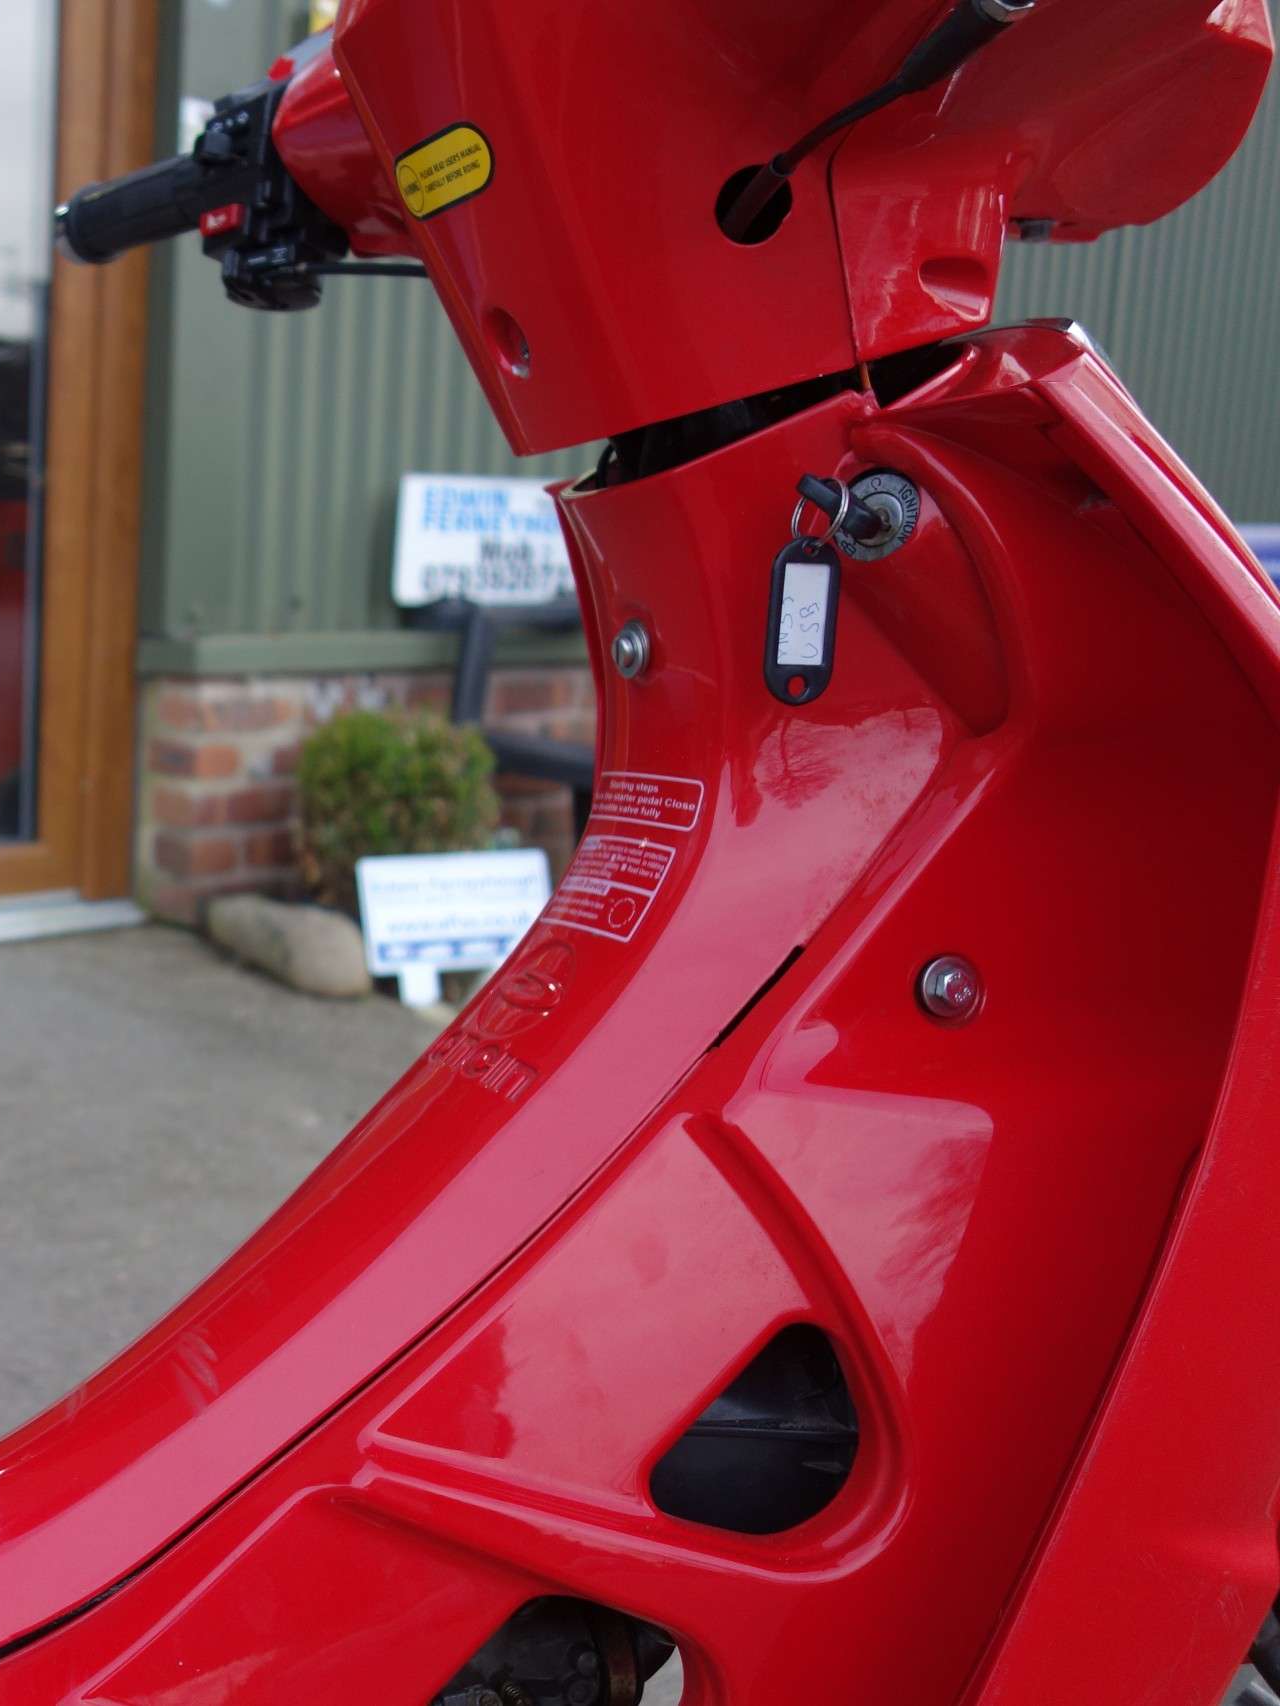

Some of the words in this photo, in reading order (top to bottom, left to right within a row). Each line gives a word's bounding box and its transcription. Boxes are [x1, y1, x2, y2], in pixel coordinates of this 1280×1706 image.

[423, 485, 510, 509] EDWIN
[897, 483, 919, 544] IGNITION
[636, 782, 659, 793] steps
[614, 792, 637, 802] starter
[637, 794, 662, 805] pedal
[664, 798, 696, 811] Close
[620, 804, 640, 814] valve
[640, 806, 661, 820] fully
